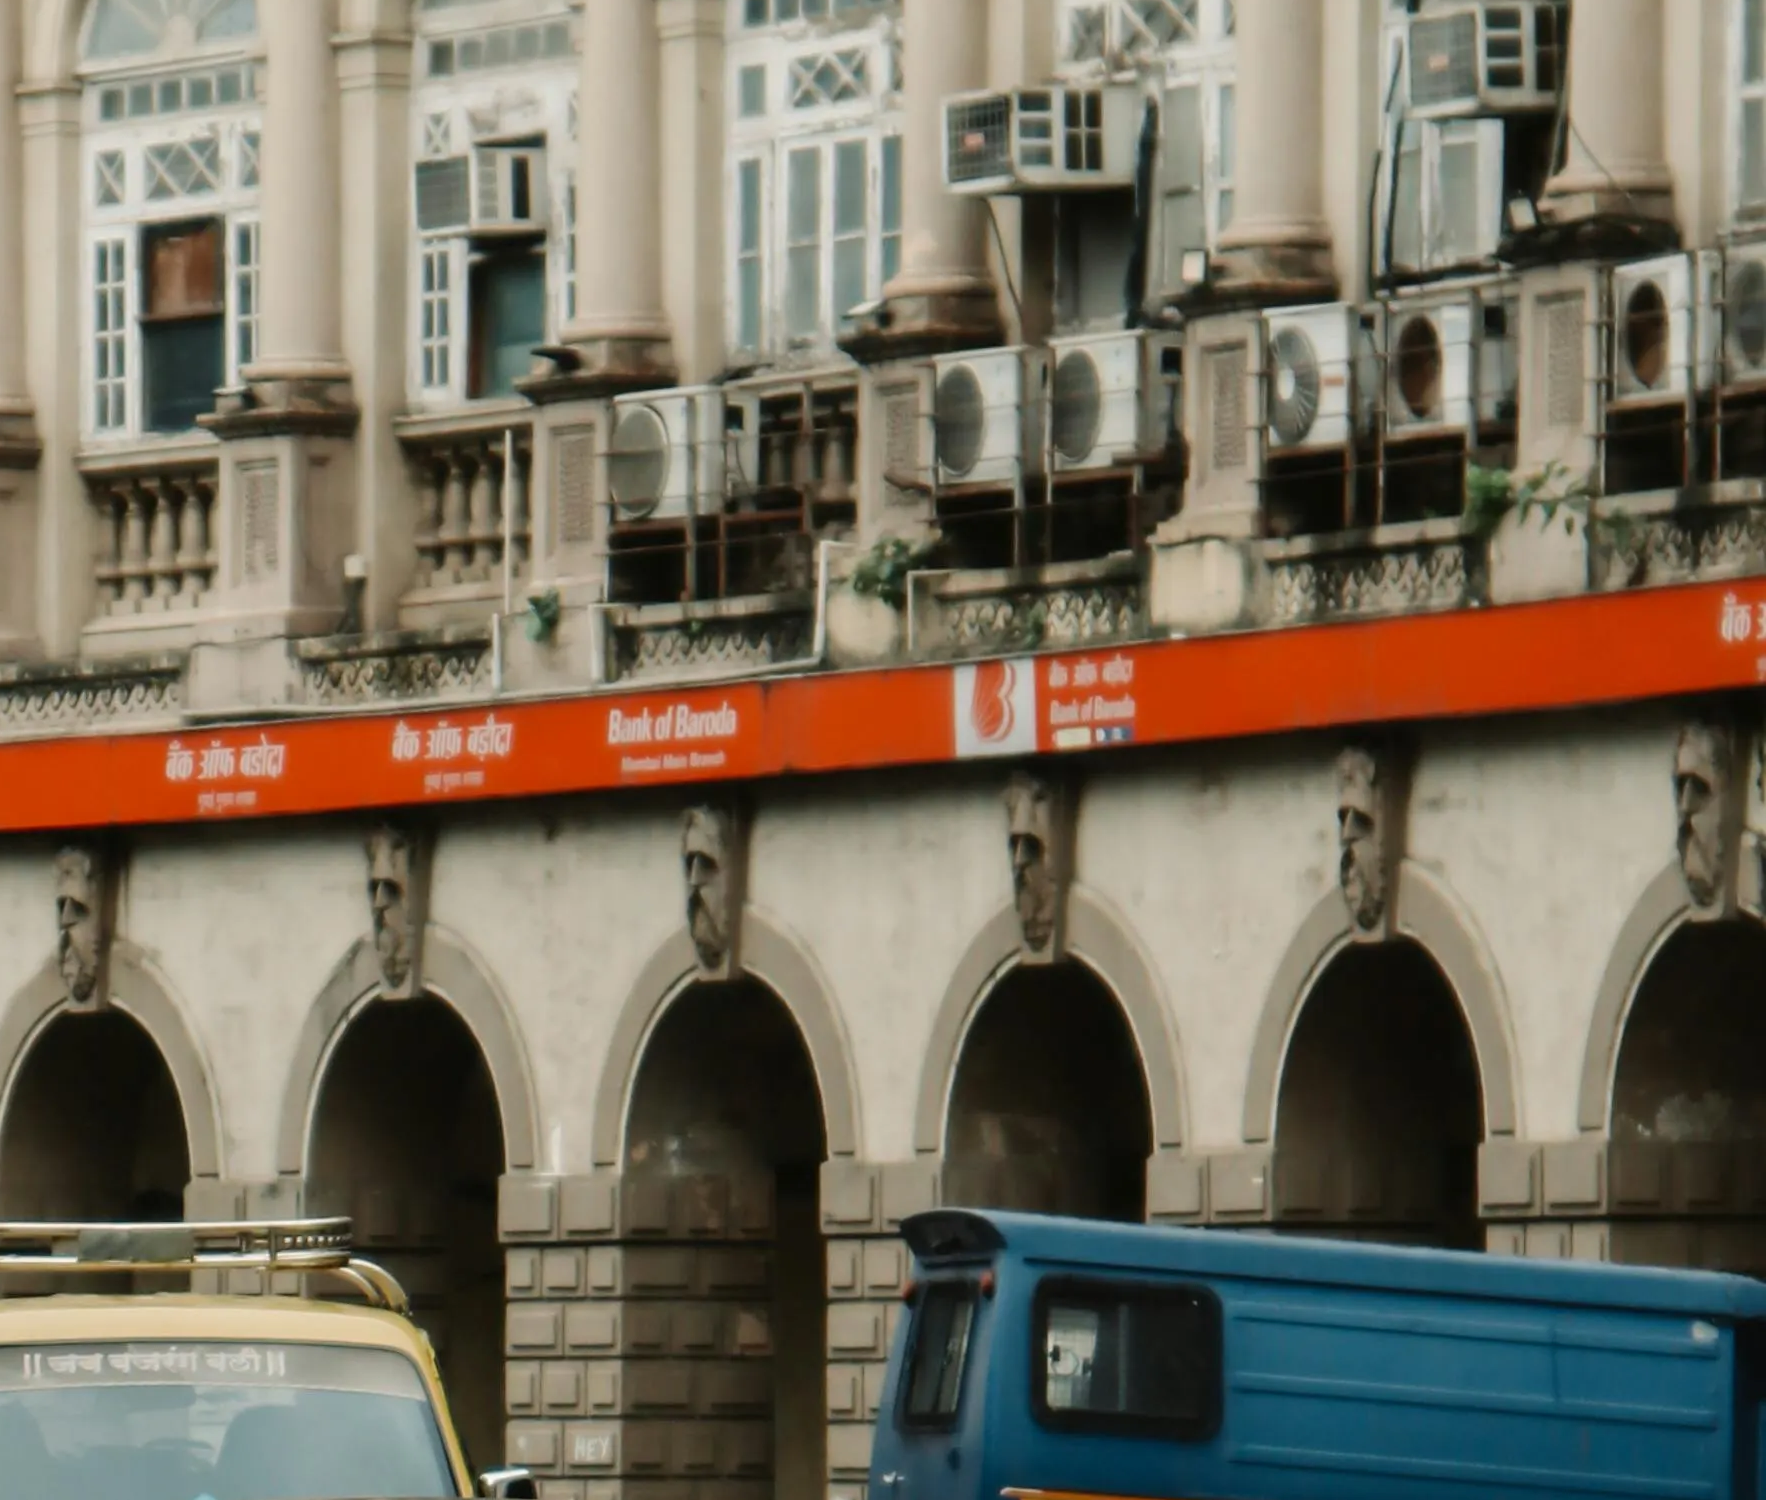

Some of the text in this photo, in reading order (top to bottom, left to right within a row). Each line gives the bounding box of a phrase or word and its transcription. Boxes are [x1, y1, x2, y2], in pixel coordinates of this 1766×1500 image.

[608, 700, 737, 745] Bank of Baroda
